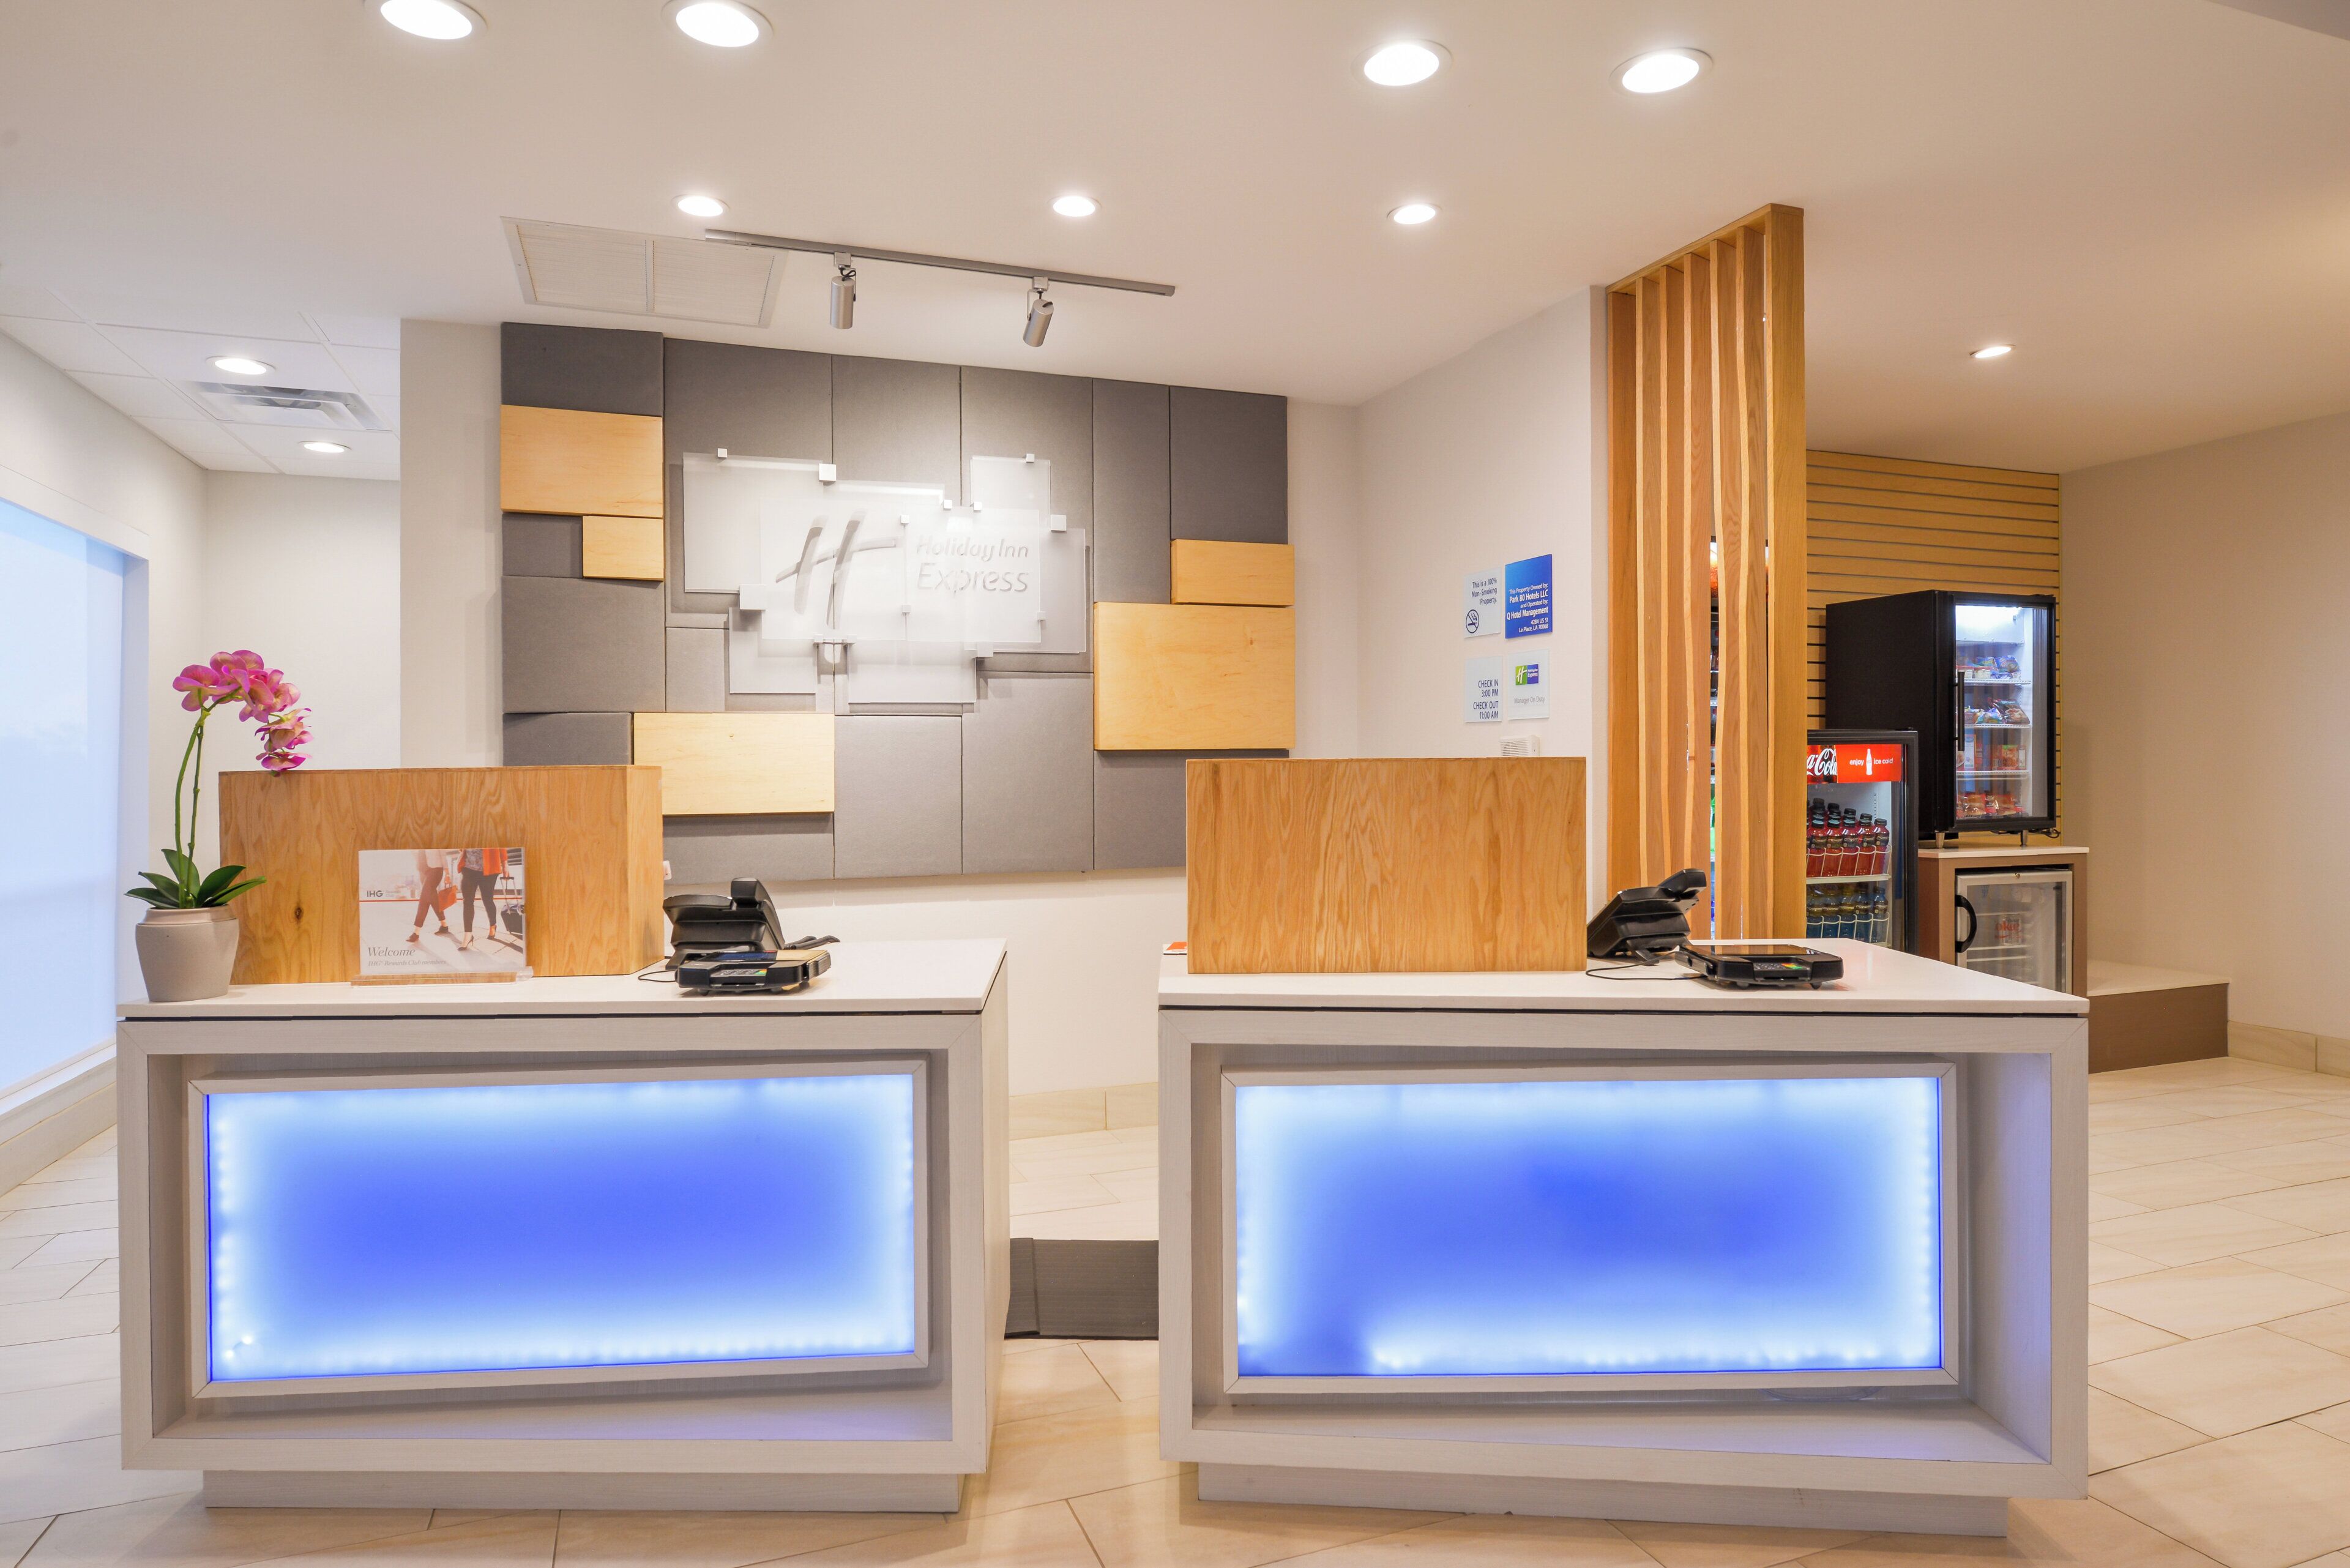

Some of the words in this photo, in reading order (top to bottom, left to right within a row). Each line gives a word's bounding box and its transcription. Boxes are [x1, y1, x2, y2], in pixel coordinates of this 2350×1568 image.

[916, 534, 996, 562] Holiday
[999, 538, 1028, 558] Inn
[918, 562, 1029, 596] Express
[1488, 577, 1497, 586] 100%
[1472, 587, 1497, 597] Non-Smoking
[1510, 595, 1519, 603] Park
[1526, 591, 1539, 600] Hotels
[1480, 597, 1497, 605] Property.
[1511, 609, 1522, 619] Hotel
[1522, 607, 1548, 617] Management
[1478, 680, 1492, 688] CHECK
[1491, 711, 1498, 719] AM
[1806, 748, 1837, 776] a-Cola
[368, 947, 415, 957] Welcome
